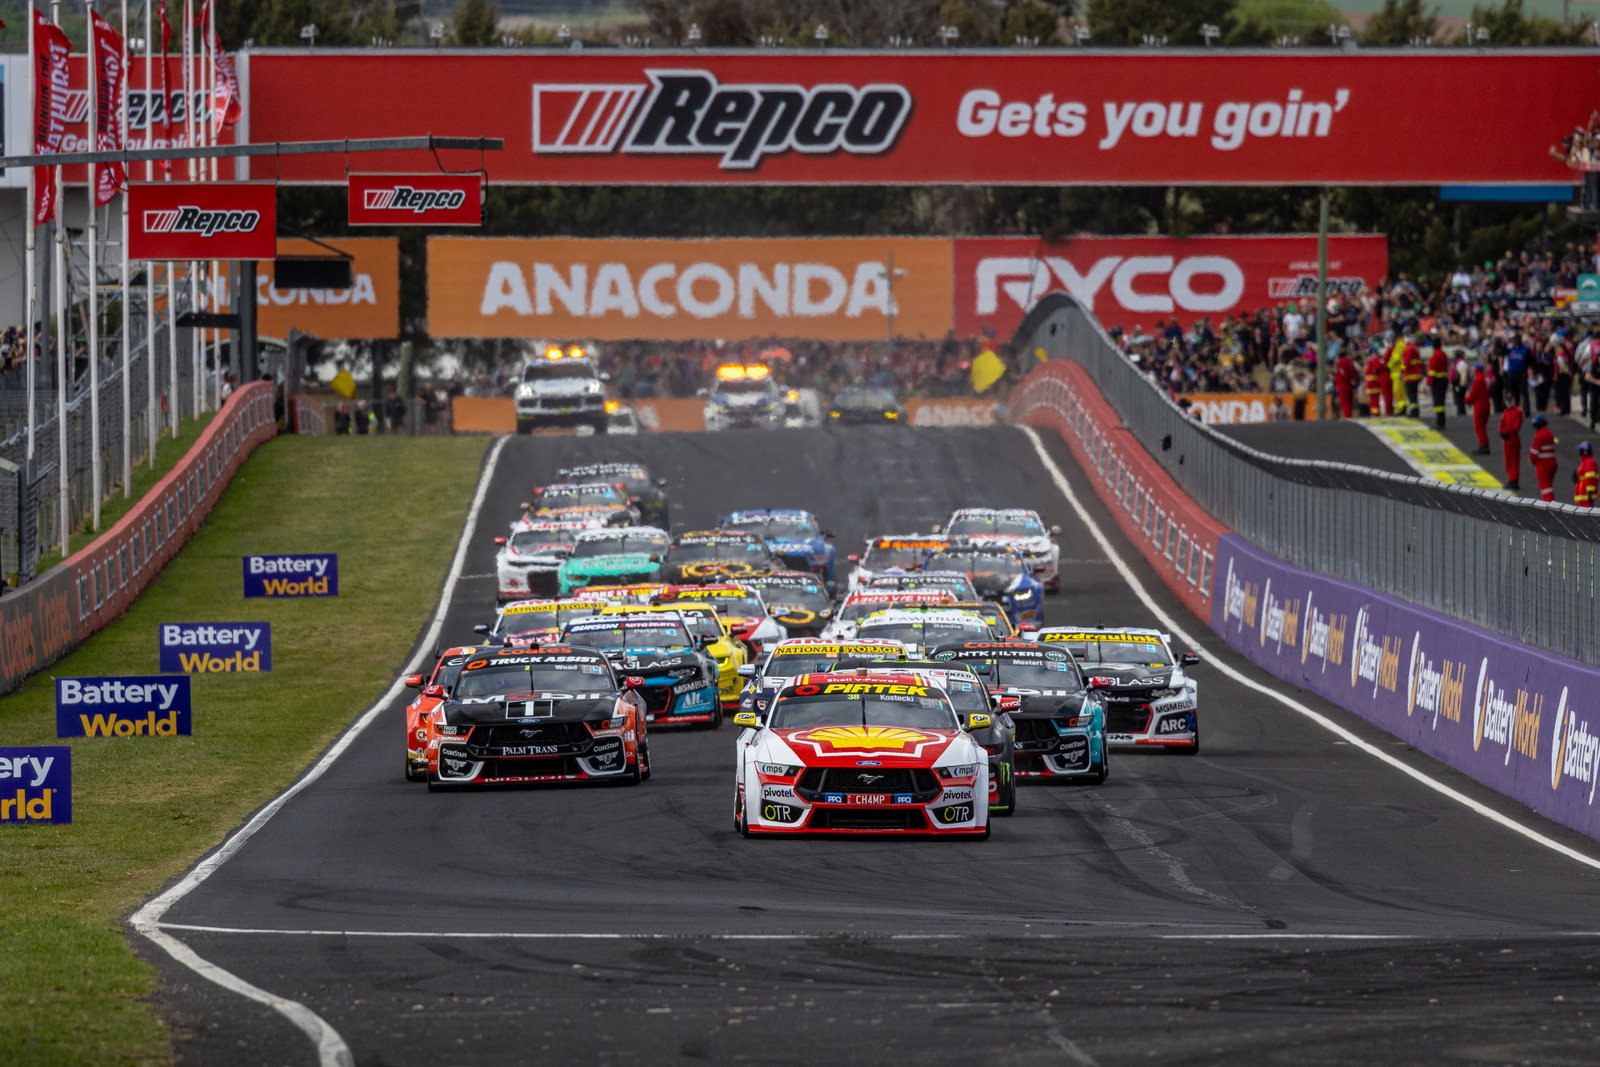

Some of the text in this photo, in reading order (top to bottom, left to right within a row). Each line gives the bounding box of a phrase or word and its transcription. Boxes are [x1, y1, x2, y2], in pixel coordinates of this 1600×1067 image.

[626, 69, 912, 168] Repco
[957, 87, 1351, 152] Gets you goin'
[391, 186, 465, 213] Repco
[174, 206, 260, 236] Repco
[480, 260, 899, 319] ANACONDA
[976, 255, 1245, 316] RYCO
[250, 556, 329, 576] Battery
[263, 576, 329, 596] World
[163, 625, 262, 650] Battery
[963, 641, 1039, 649] Coates
[1044, 632, 1161, 645] Hydraulink
[1309, 606, 1347, 674] Battery World
[497, 647, 573, 656] Coates
[777, 645, 901, 655] NATIONAL STORAGE
[958, 650, 989, 658] NTK
[178, 651, 260, 673] World
[490, 656, 600, 667] TRUCK ASSIST
[1358, 626, 1401, 700] Battery World
[61, 679, 179, 710] Battery
[823, 683, 929, 697] PIRTEK
[879, 694, 915, 702] Kostecki
[1416, 651, 1466, 731] Battery World
[80, 711, 178, 738] World
[1484, 679, 1544, 766] Battery World
[502, 745, 558, 756] PALM TRANS
[1563, 710, 1600, 806] Battery
[0, 757, 55, 787] ery
[766, 765, 783, 775] mps
[958, 765, 974, 776] mps
[0, 788, 52, 819] rld
[855, 795, 885, 805] CH4MP
[764, 804, 792, 821] OTR
[944, 806, 970, 822] OTR
